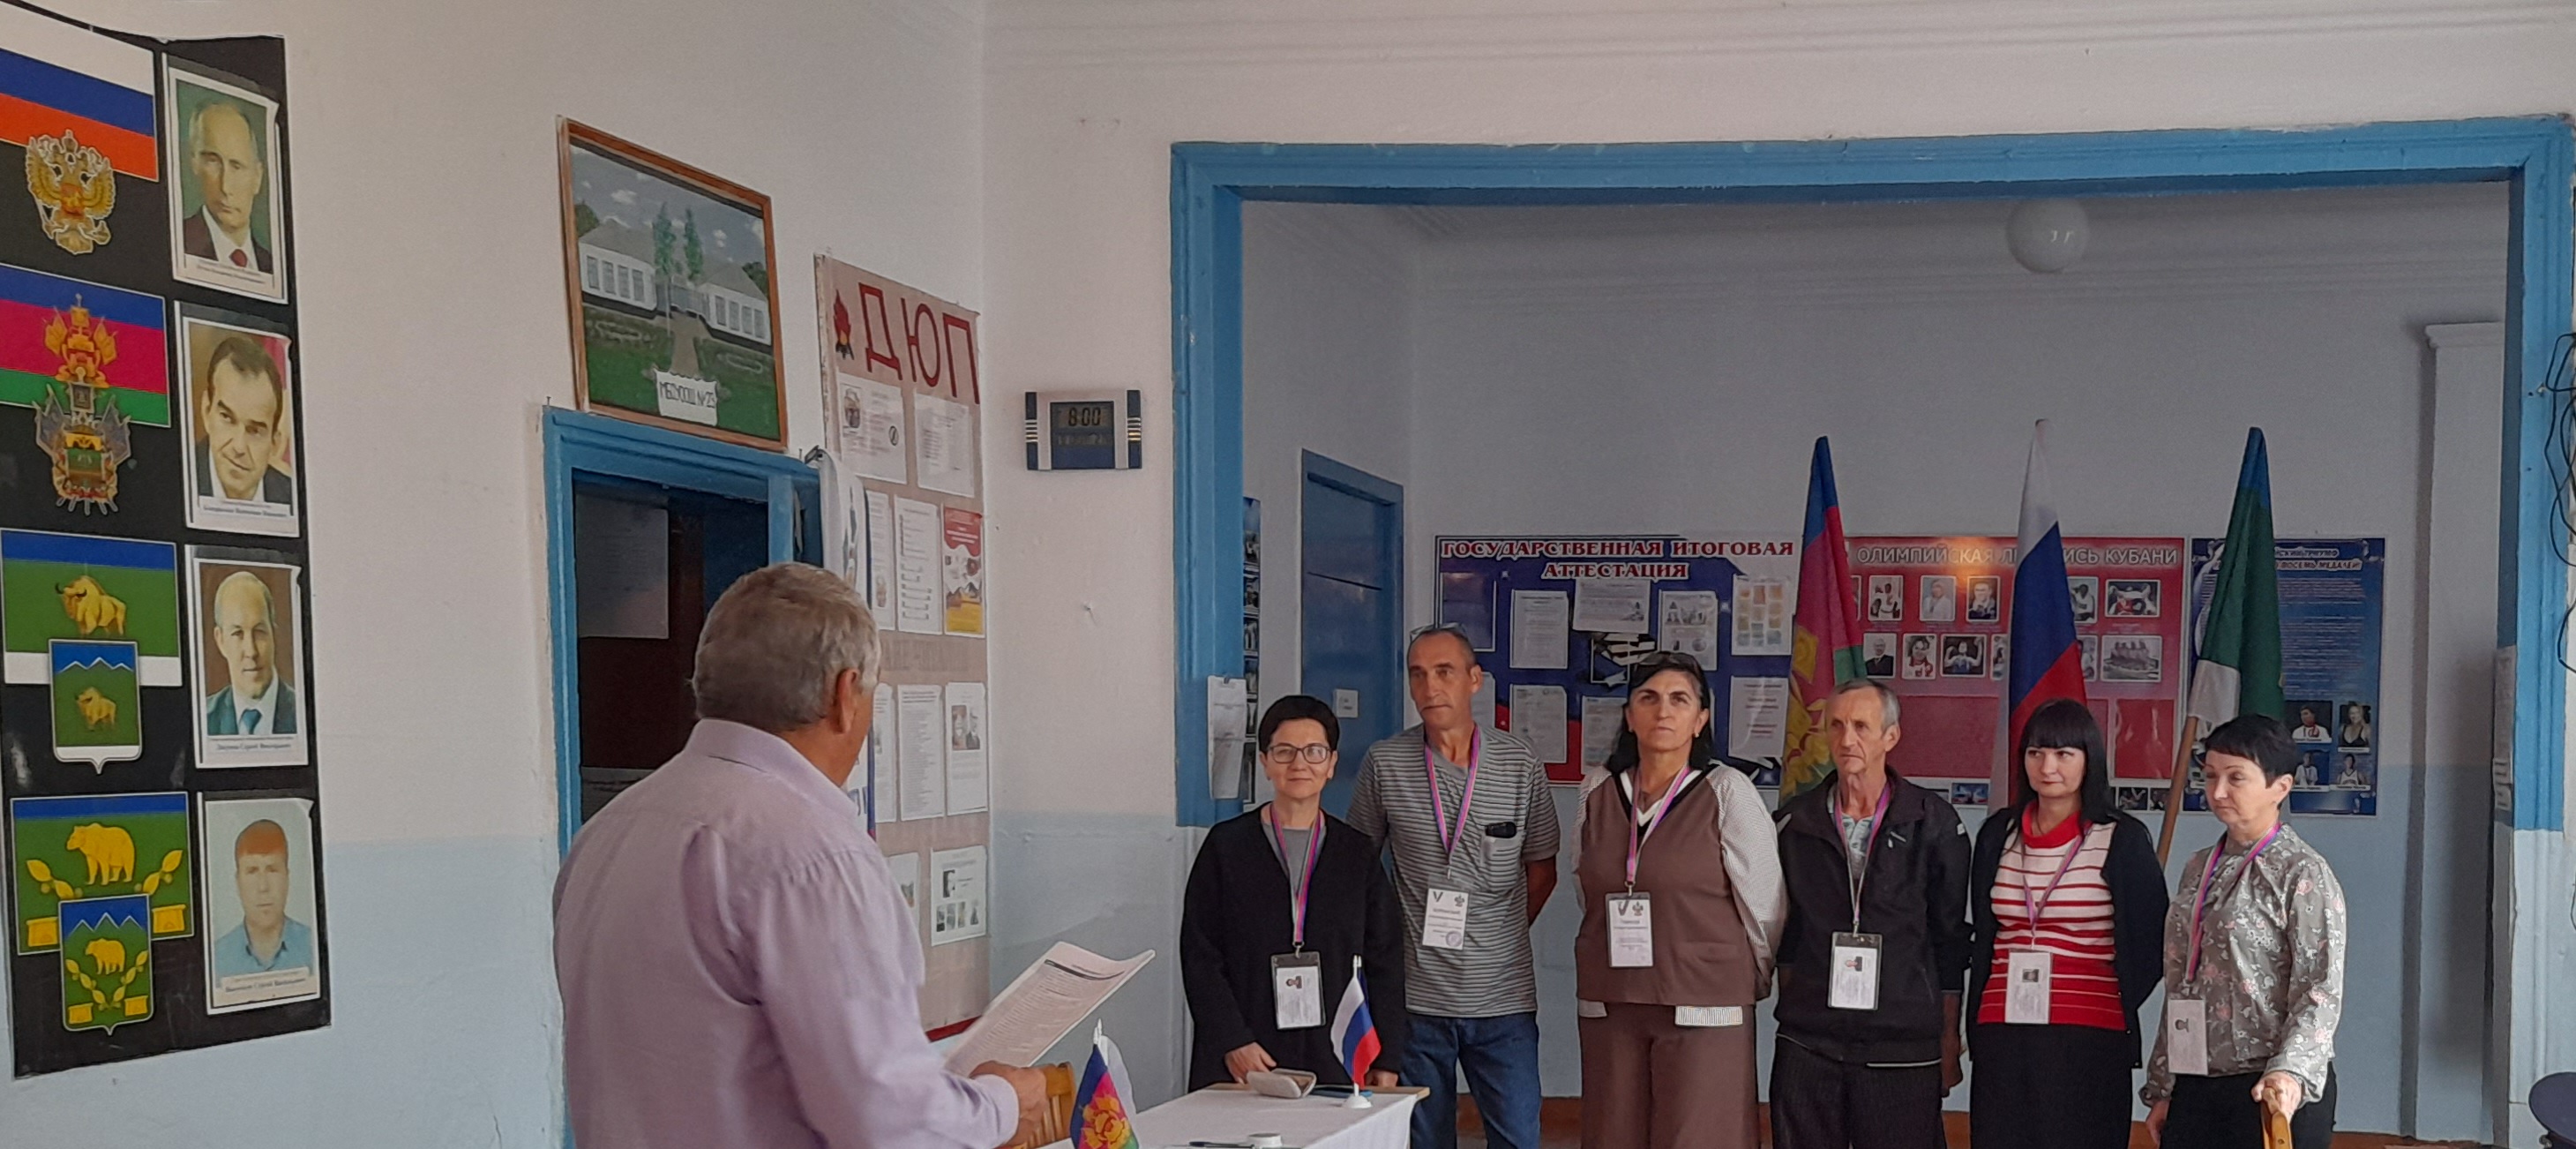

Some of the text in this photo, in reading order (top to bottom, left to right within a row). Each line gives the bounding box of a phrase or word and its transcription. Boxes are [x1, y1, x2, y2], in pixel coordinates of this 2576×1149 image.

[858, 282, 980, 405] ДЮП
[1442, 541, 1794, 559] ГОСУДАРСТВЕННАЯ ИТОГОВАЯ
[1857, 544, 1995, 564] ОЛИМПИЙСКАЯ
[2105, 548, 2178, 565] КУБАНИ
[1544, 563, 1689, 580] АТТЕСТАЦИЯ
